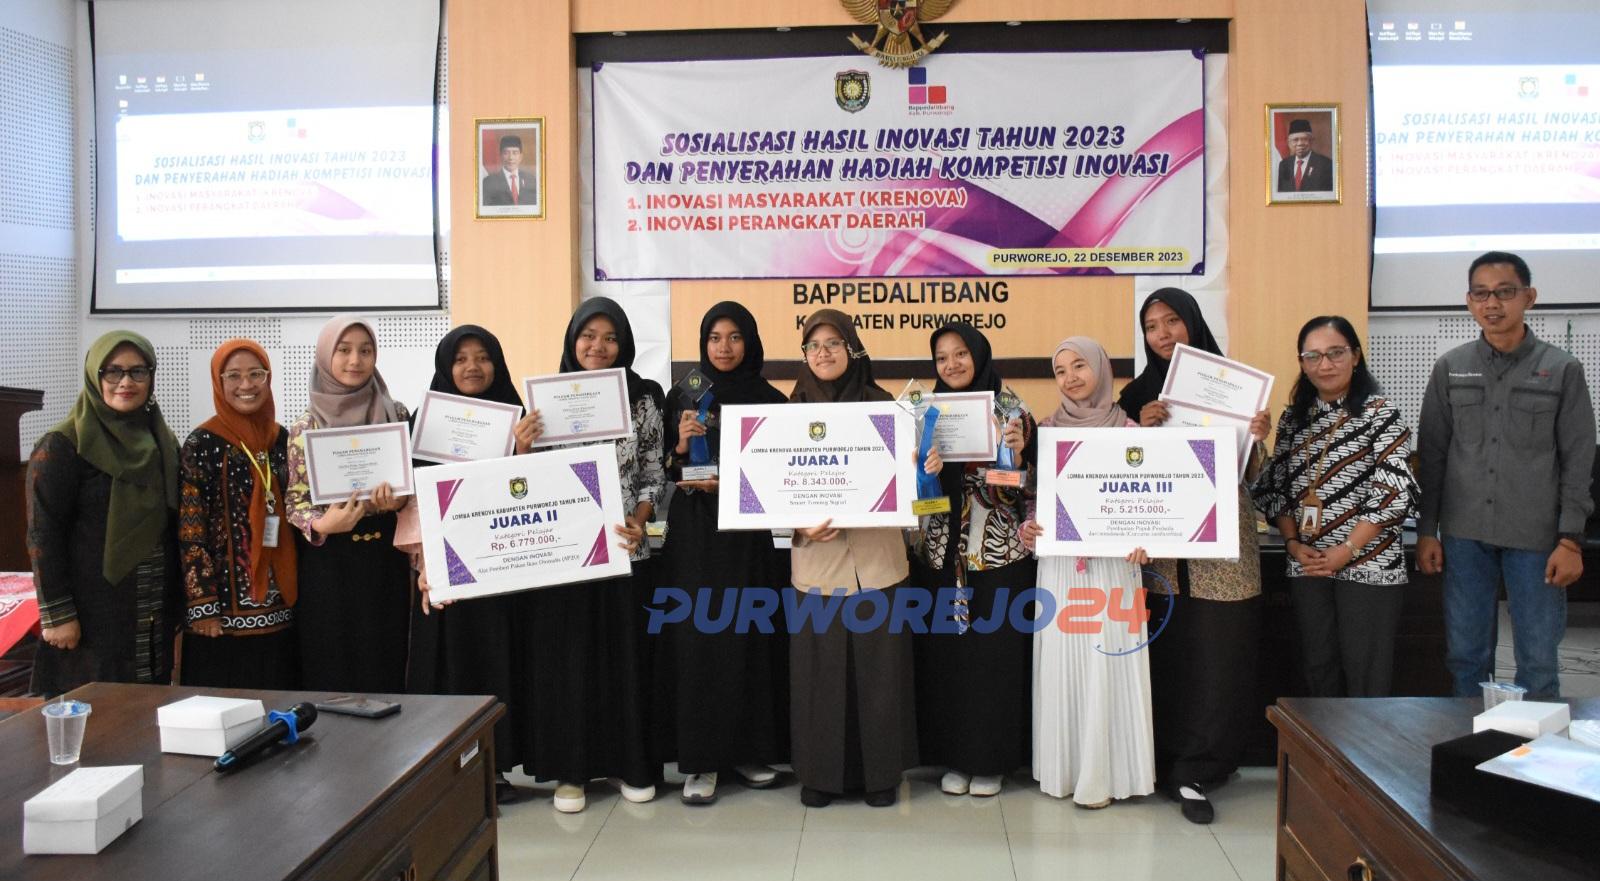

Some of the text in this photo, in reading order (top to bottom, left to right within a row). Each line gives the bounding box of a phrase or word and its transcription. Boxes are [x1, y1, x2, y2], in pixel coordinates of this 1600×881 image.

[1402, 112, 1492, 126] SOSIALISASI
[1497, 112, 1539, 125] HASIL
[661, 125, 1126, 156] SOSIALISASI HASIL INOVASI TAHUN 2023
[1376, 131, 1409, 144] DAN
[1415, 131, 1515, 144] PENYERAHAN
[1521, 130, 1579, 143] HADIAH
[153, 150, 407, 169] SOSIALISASI HASIL INOVASI TAHUN 2023
[624, 153, 1171, 184] DAN PENYERAHAN HADIAH KOMPETISI INOVASI
[135, 166, 432, 186] DAN PENYERAHAN HADIAH KOMPETISI INOVASI
[627, 189, 968, 210] 1. INOVASI MASYARAKAT (KRENOVA)
[627, 213, 926, 232] 2. INOVASI PERANGKAT DAERAH
[993, 252, 1184, 264] PURWOREJO, 22 DESEMBER 2023
[792, 281, 1009, 305] BAPPEDALITBANG
[796, 313, 1006, 330] KATEN PURWOREJO
[788, 454, 849, 467] JUARA I
[783, 477, 853, 488] Rp. 8.343.000,-
[1098, 481, 1173, 493] JUARA III
[1100, 505, 1171, 515] Rp. 5.215.000,-
[489, 509, 558, 530] JUARA II
[491, 535, 561, 553] Rp. 6.779.000,-
